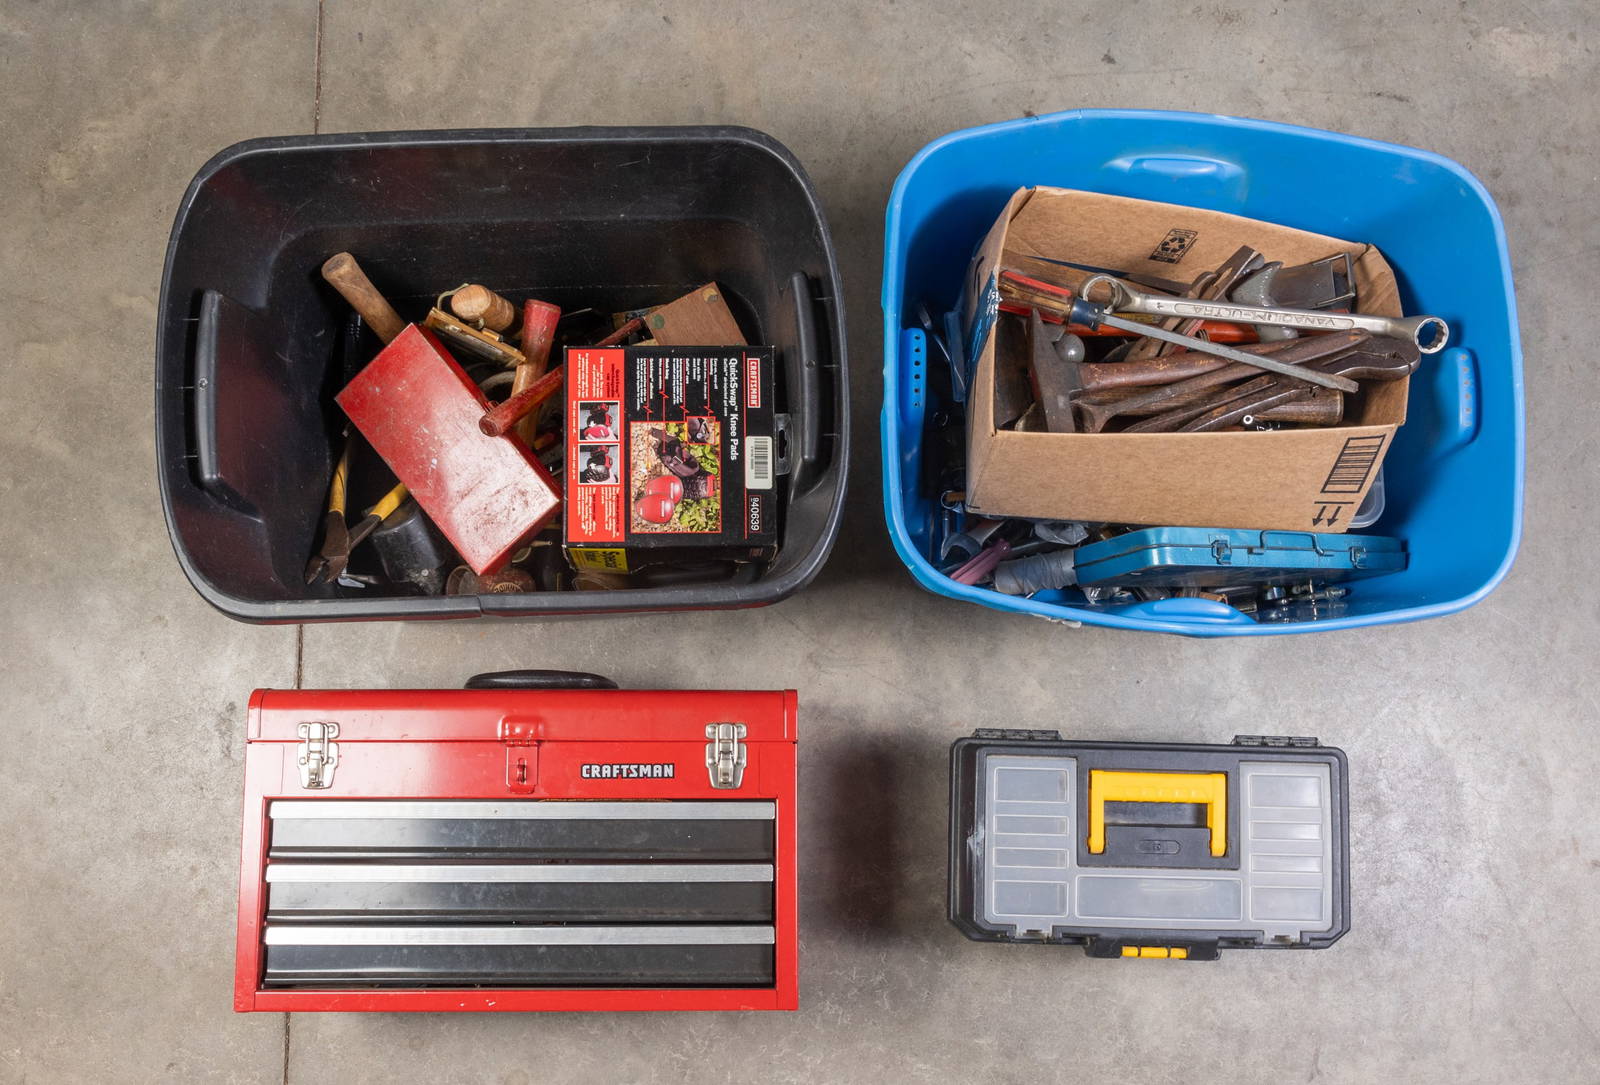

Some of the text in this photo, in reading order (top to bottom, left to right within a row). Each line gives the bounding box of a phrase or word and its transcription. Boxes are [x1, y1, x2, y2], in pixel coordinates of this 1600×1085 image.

[749, 361, 758, 406] CRAFTSMAN
[730, 413, 738, 438] Knee
[730, 439, 738, 460] Pads
[750, 497, 760, 531] 940639
[581, 763, 675, 779] CRAFTSMAN
